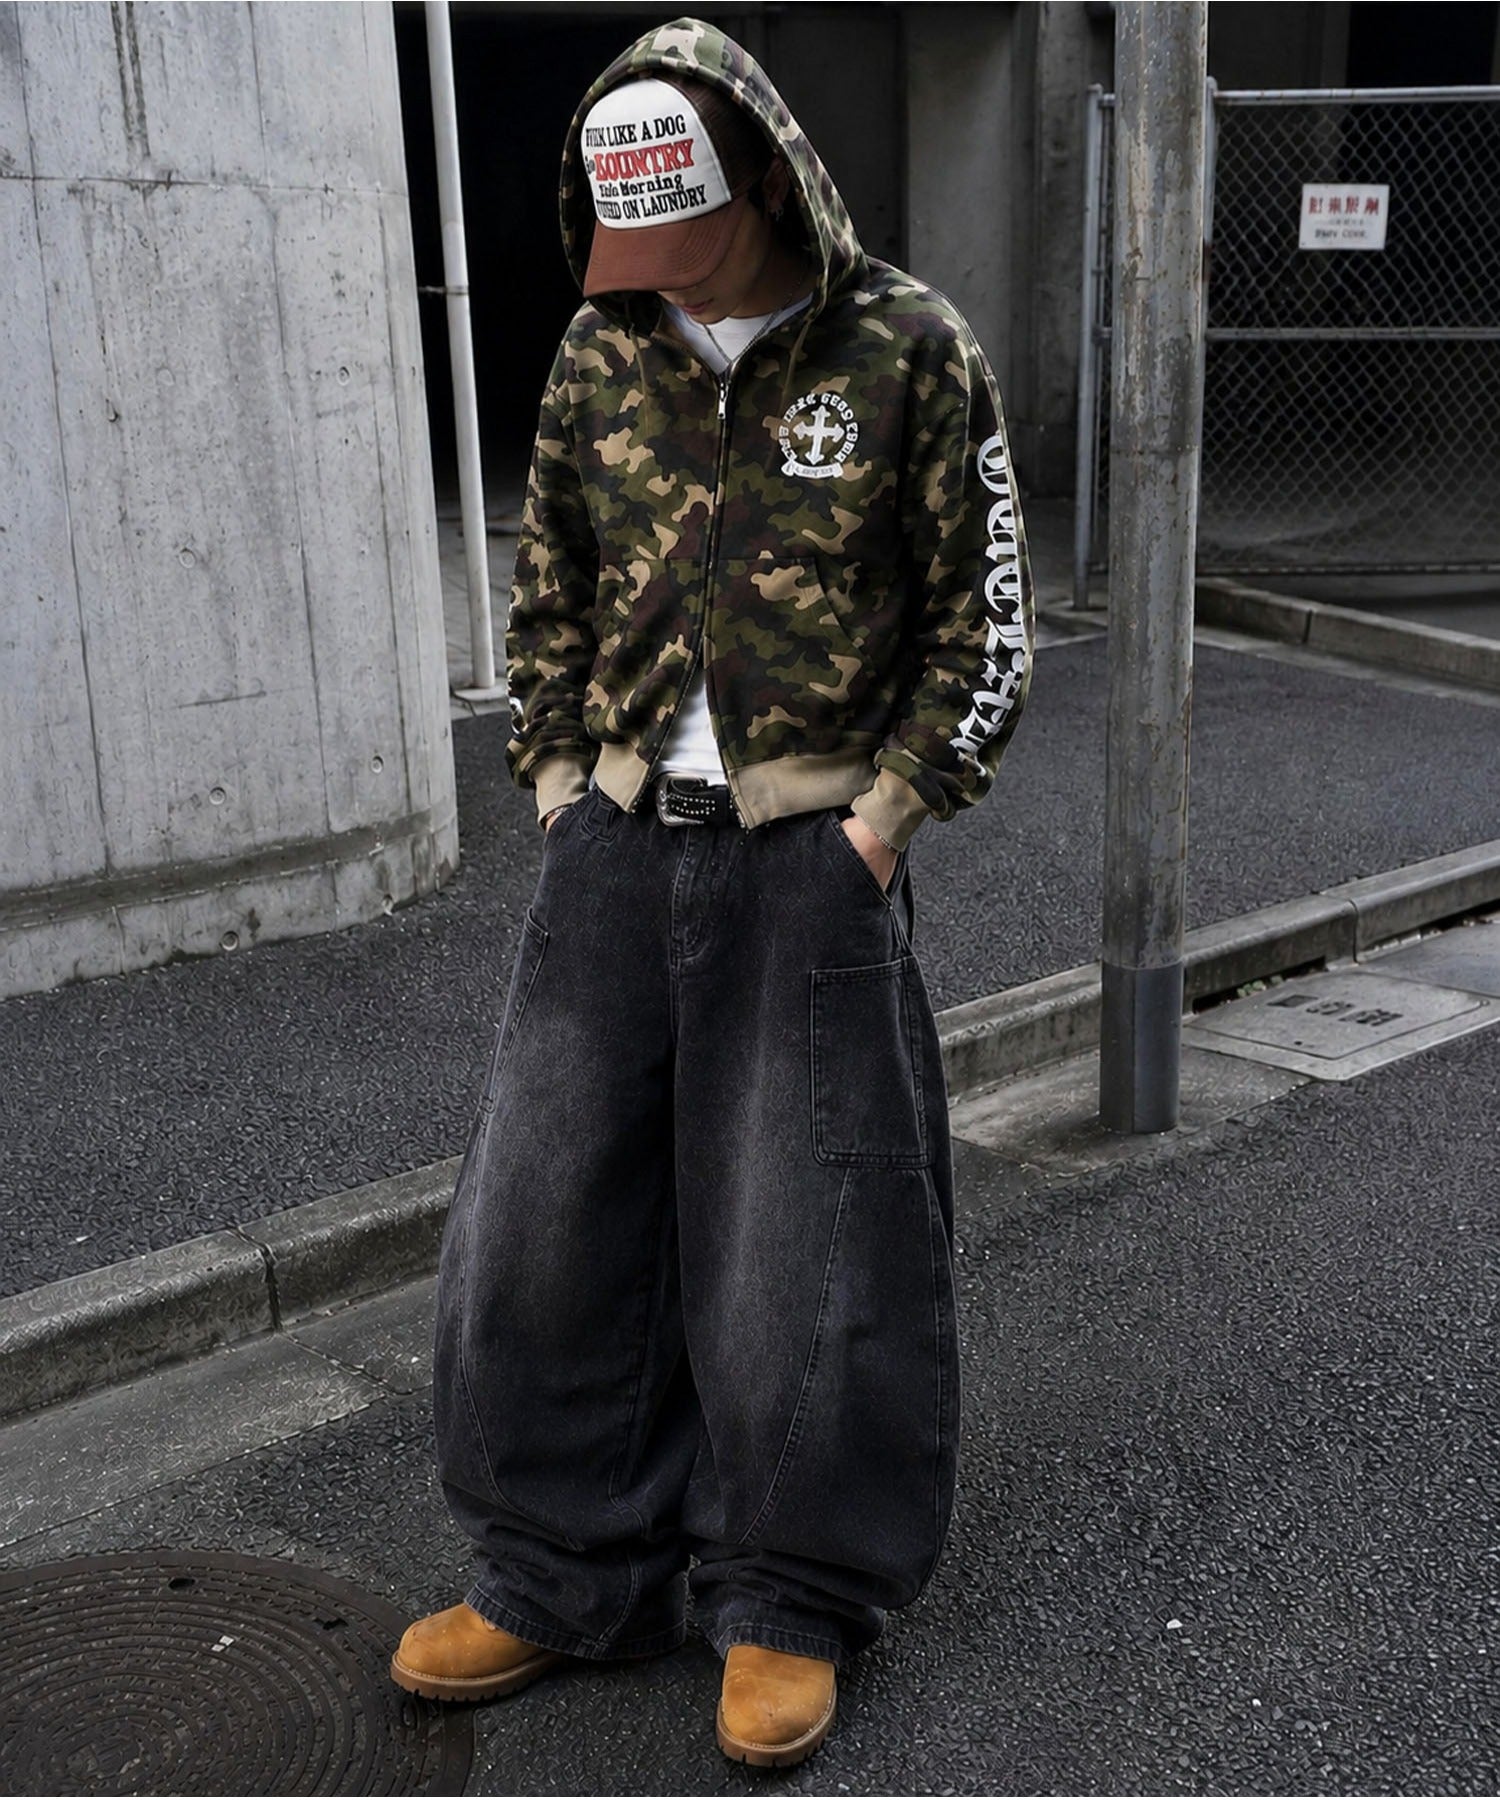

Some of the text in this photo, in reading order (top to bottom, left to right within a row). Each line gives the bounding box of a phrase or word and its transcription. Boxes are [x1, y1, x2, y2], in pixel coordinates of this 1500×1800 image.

[606, 124, 637, 147] LIKE
[641, 121, 653, 141] A
[654, 114, 687, 139] DOG
[620, 173, 685, 197] Morning
[622, 199, 641, 219] ON
[640, 184, 708, 218] LAUNDRY
